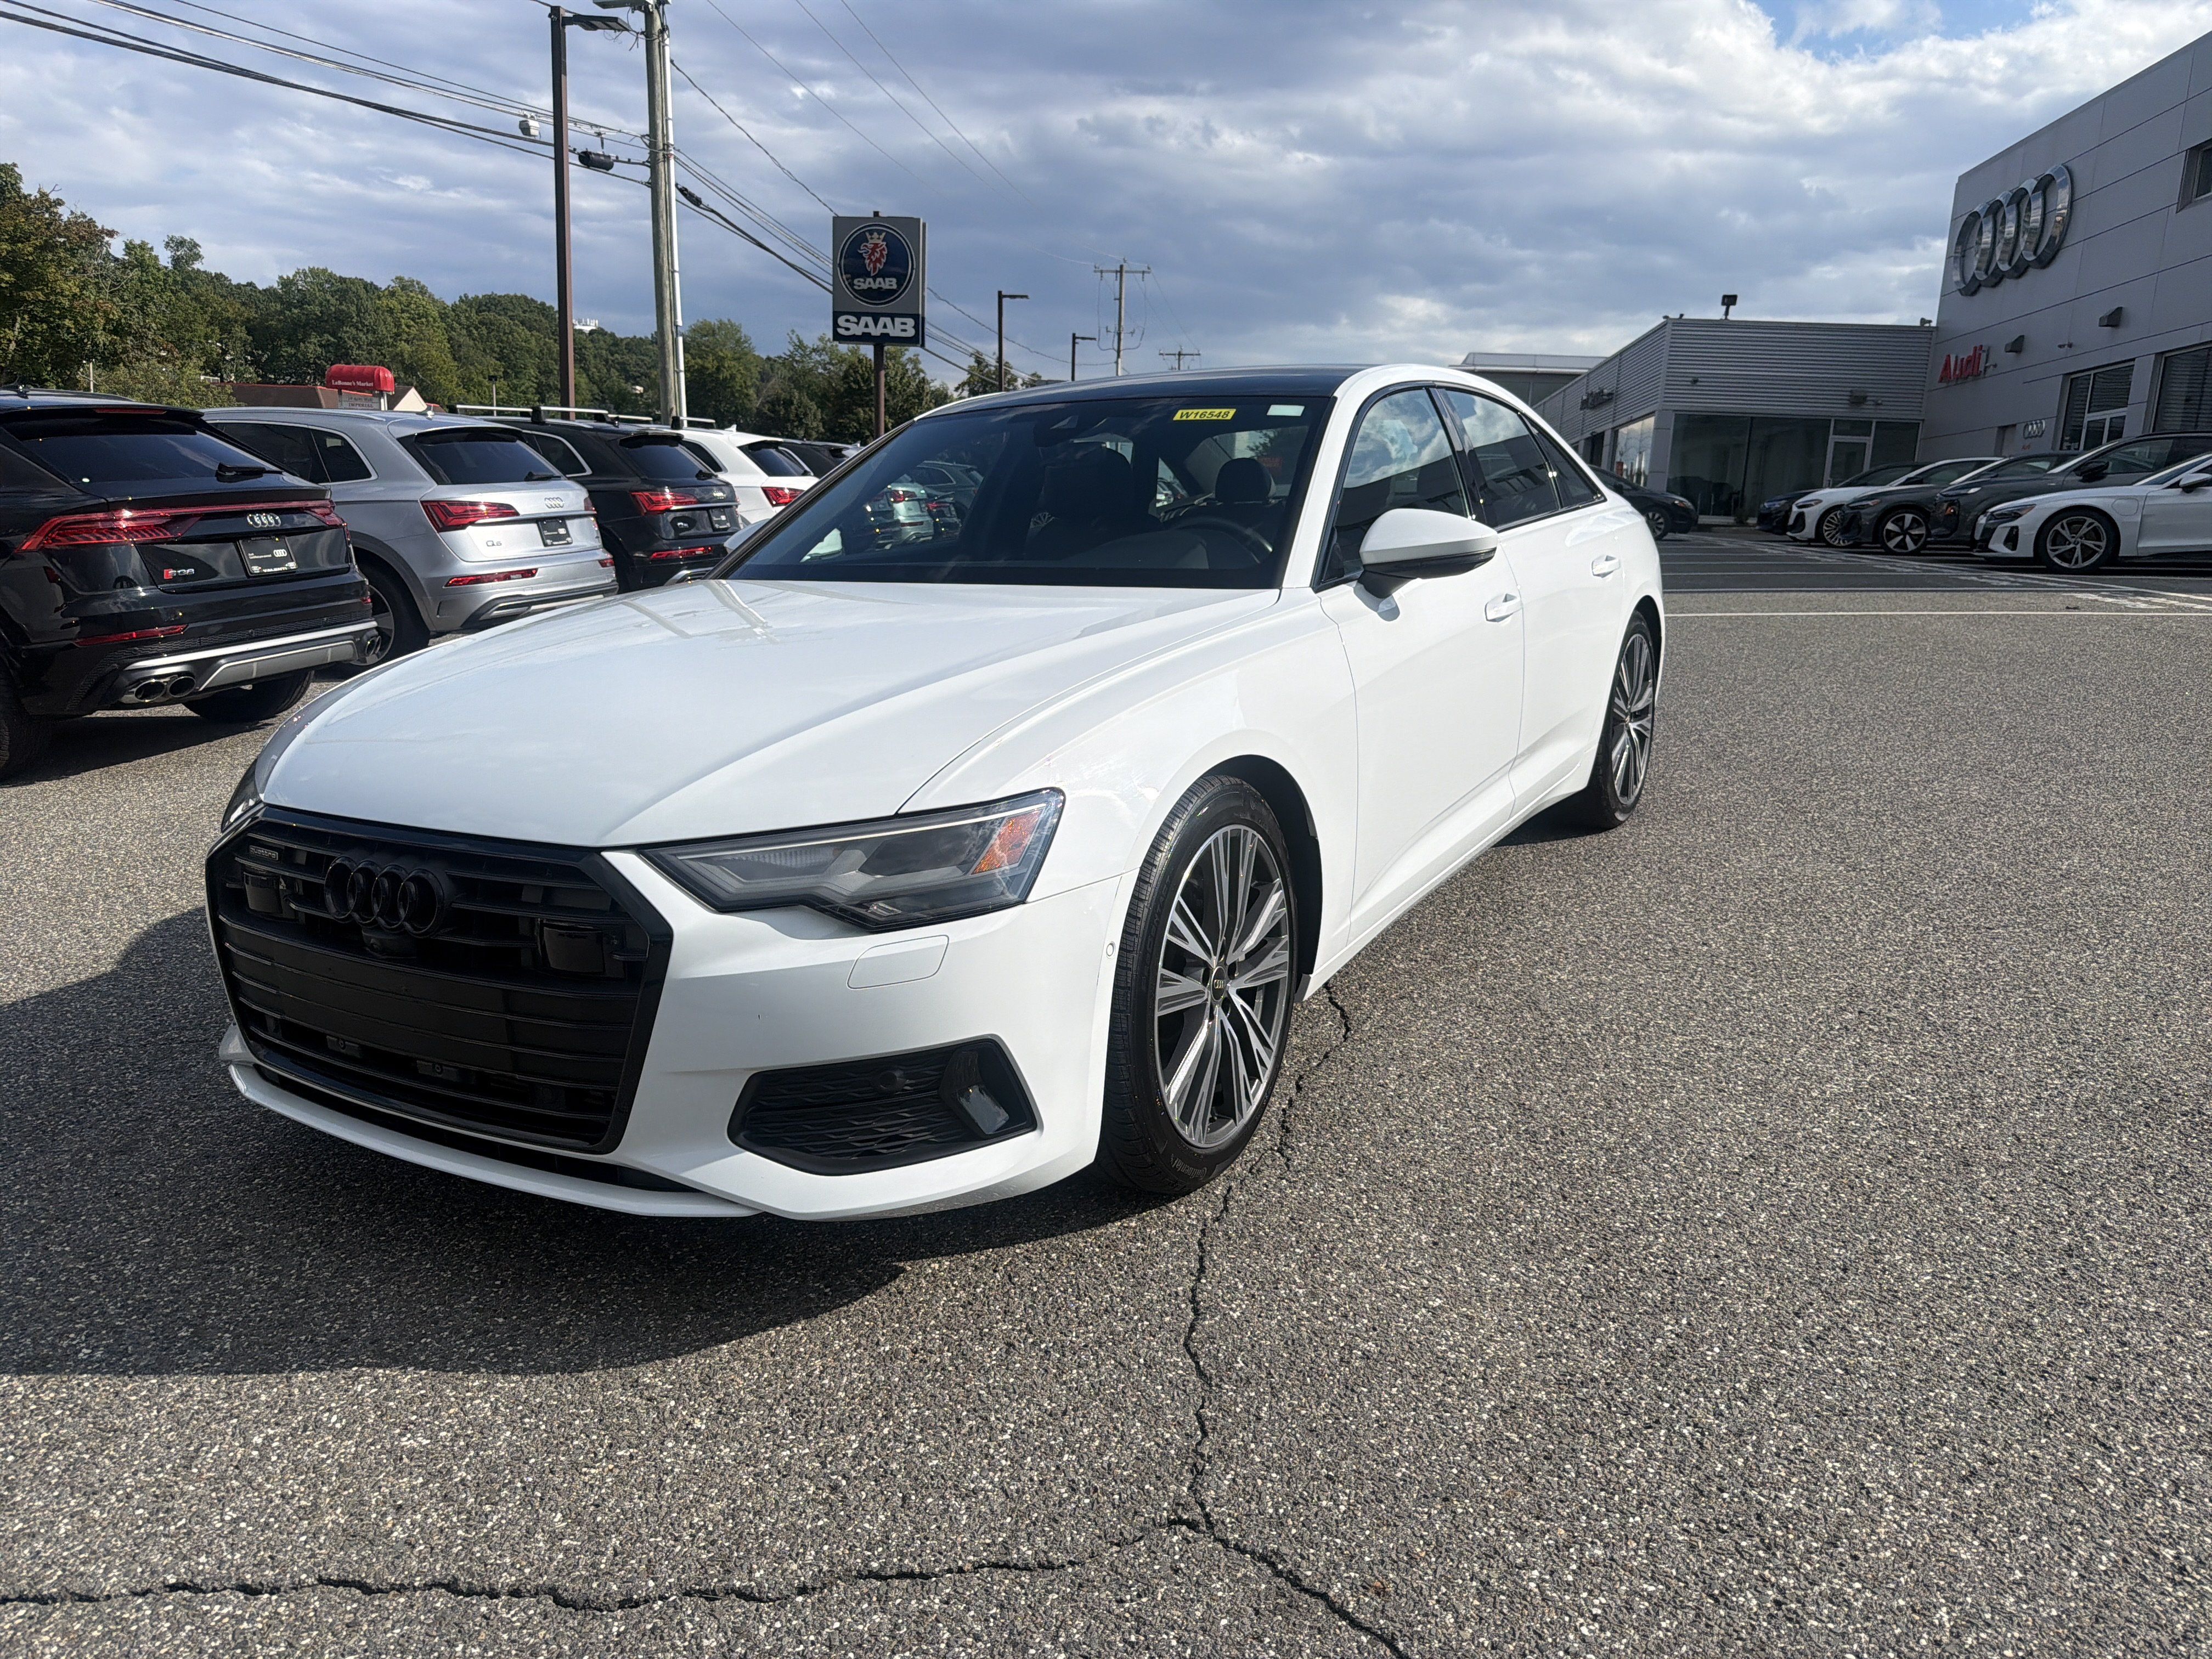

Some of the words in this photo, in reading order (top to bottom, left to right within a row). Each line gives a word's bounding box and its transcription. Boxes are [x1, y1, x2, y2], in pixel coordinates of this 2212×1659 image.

[853, 277, 897, 290] SAAB
[837, 315, 916, 337] SAAB
[1938, 345, 1983, 383] Audi
[250, 847, 276, 859] quattro
